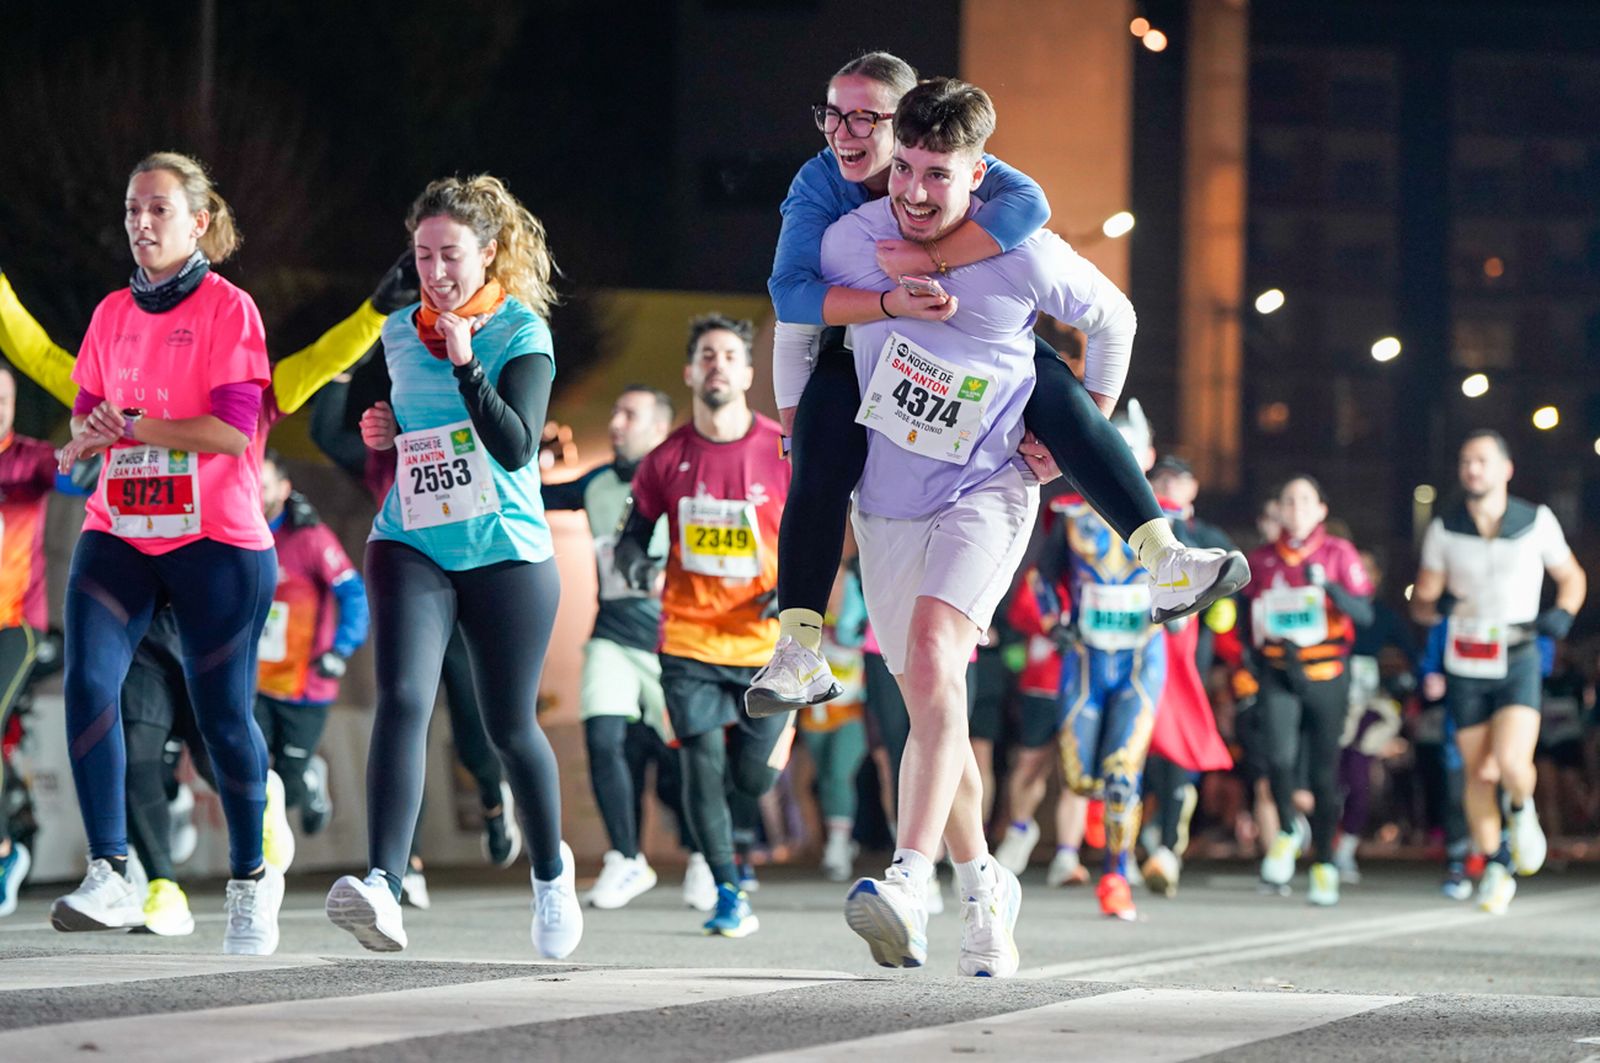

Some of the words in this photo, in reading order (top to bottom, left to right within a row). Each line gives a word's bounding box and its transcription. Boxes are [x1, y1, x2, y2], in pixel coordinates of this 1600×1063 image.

[119, 368, 139, 381] WE
[891, 358, 913, 377] SAN
[911, 371, 949, 396] ANTÓN
[906, 354, 940, 378] NOCHE
[938, 371, 954, 384] DE
[116, 388, 169, 401] RUN
[892, 379, 962, 428] 4374
[894, 410, 911, 423] JOSE
[910, 420, 943, 435] ANTONIO
[113, 467, 129, 478] SAN
[410, 458, 472, 495] 2553
[123, 478, 175, 507] 9721
[696, 528, 748, 549] 2349
